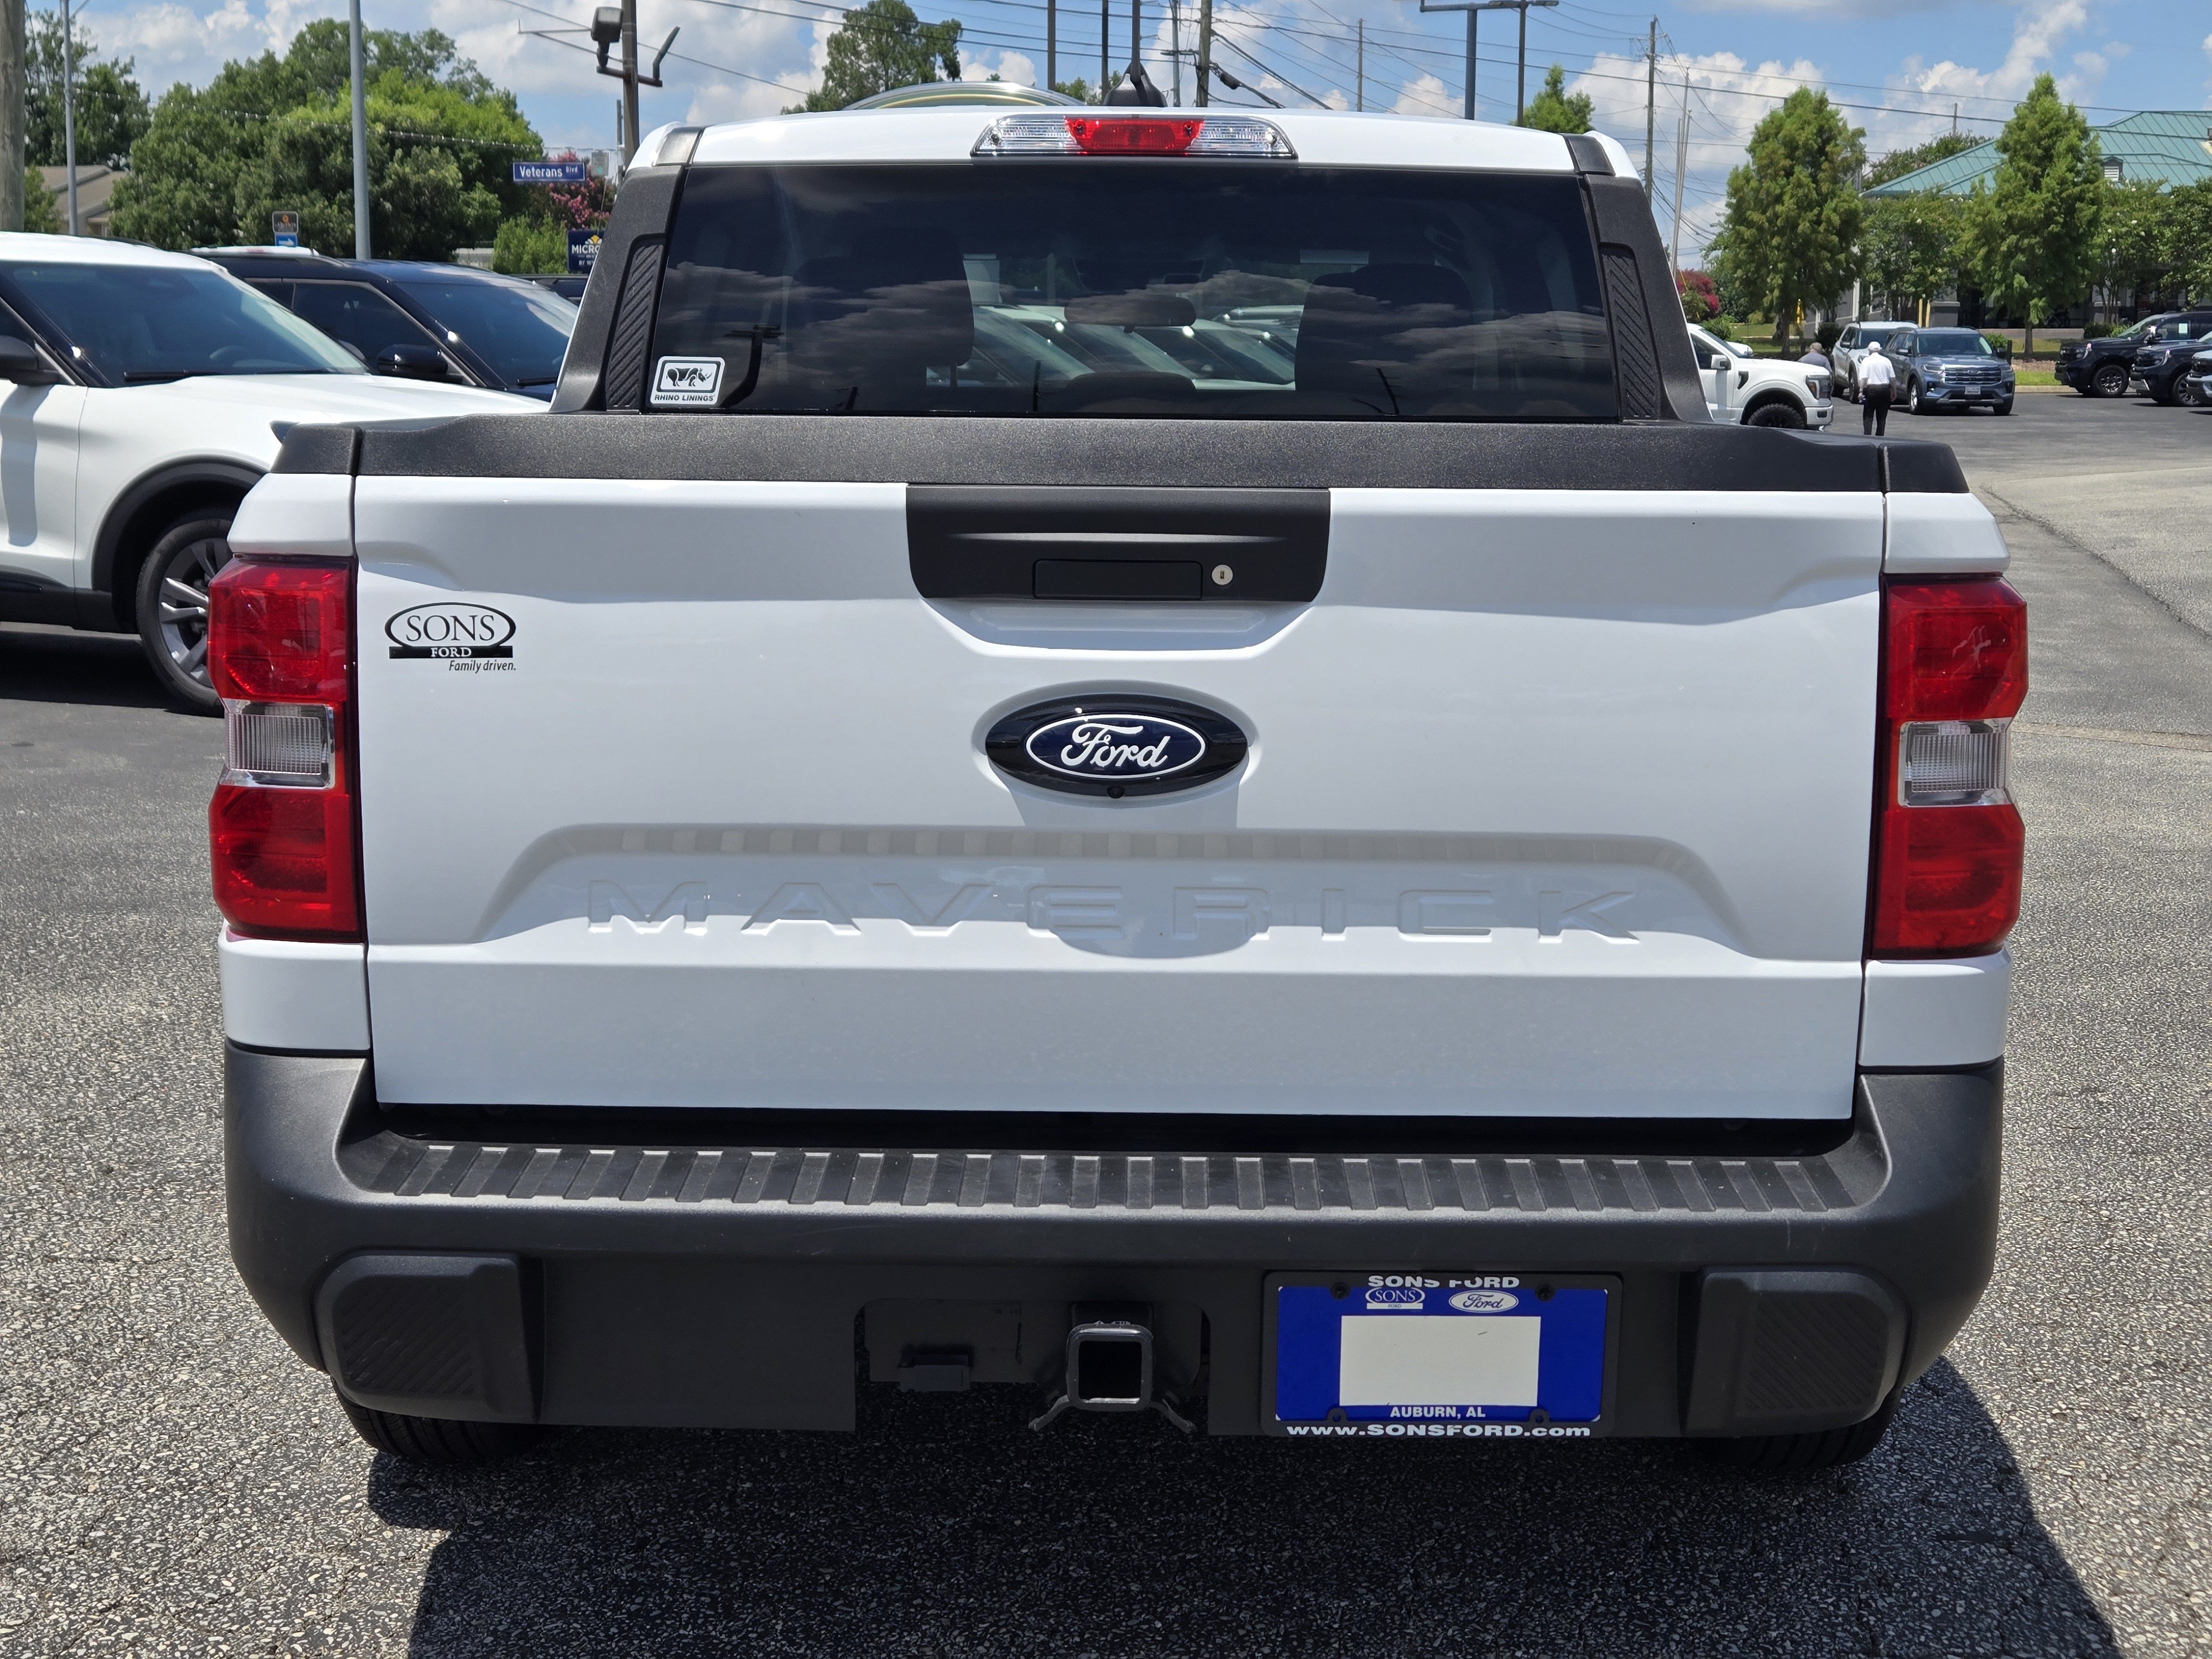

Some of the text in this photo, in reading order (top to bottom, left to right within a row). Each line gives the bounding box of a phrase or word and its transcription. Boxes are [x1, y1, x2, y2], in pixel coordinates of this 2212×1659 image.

[519, 165, 563, 178] Veterans
[405, 614, 494, 642] SONS
[430, 647, 472, 658] FORD
[448, 660, 517, 674] Family driven.
[1060, 722, 1171, 768] Ford
[588, 879, 1641, 943] MAVERICK
[1374, 1290, 1416, 1302] SONS
[1462, 1293, 1505, 1309] Ford
[1390, 1406, 1486, 1419] AUBURN, AL
[1286, 1424, 1590, 1437] www.SONSFORD.com
